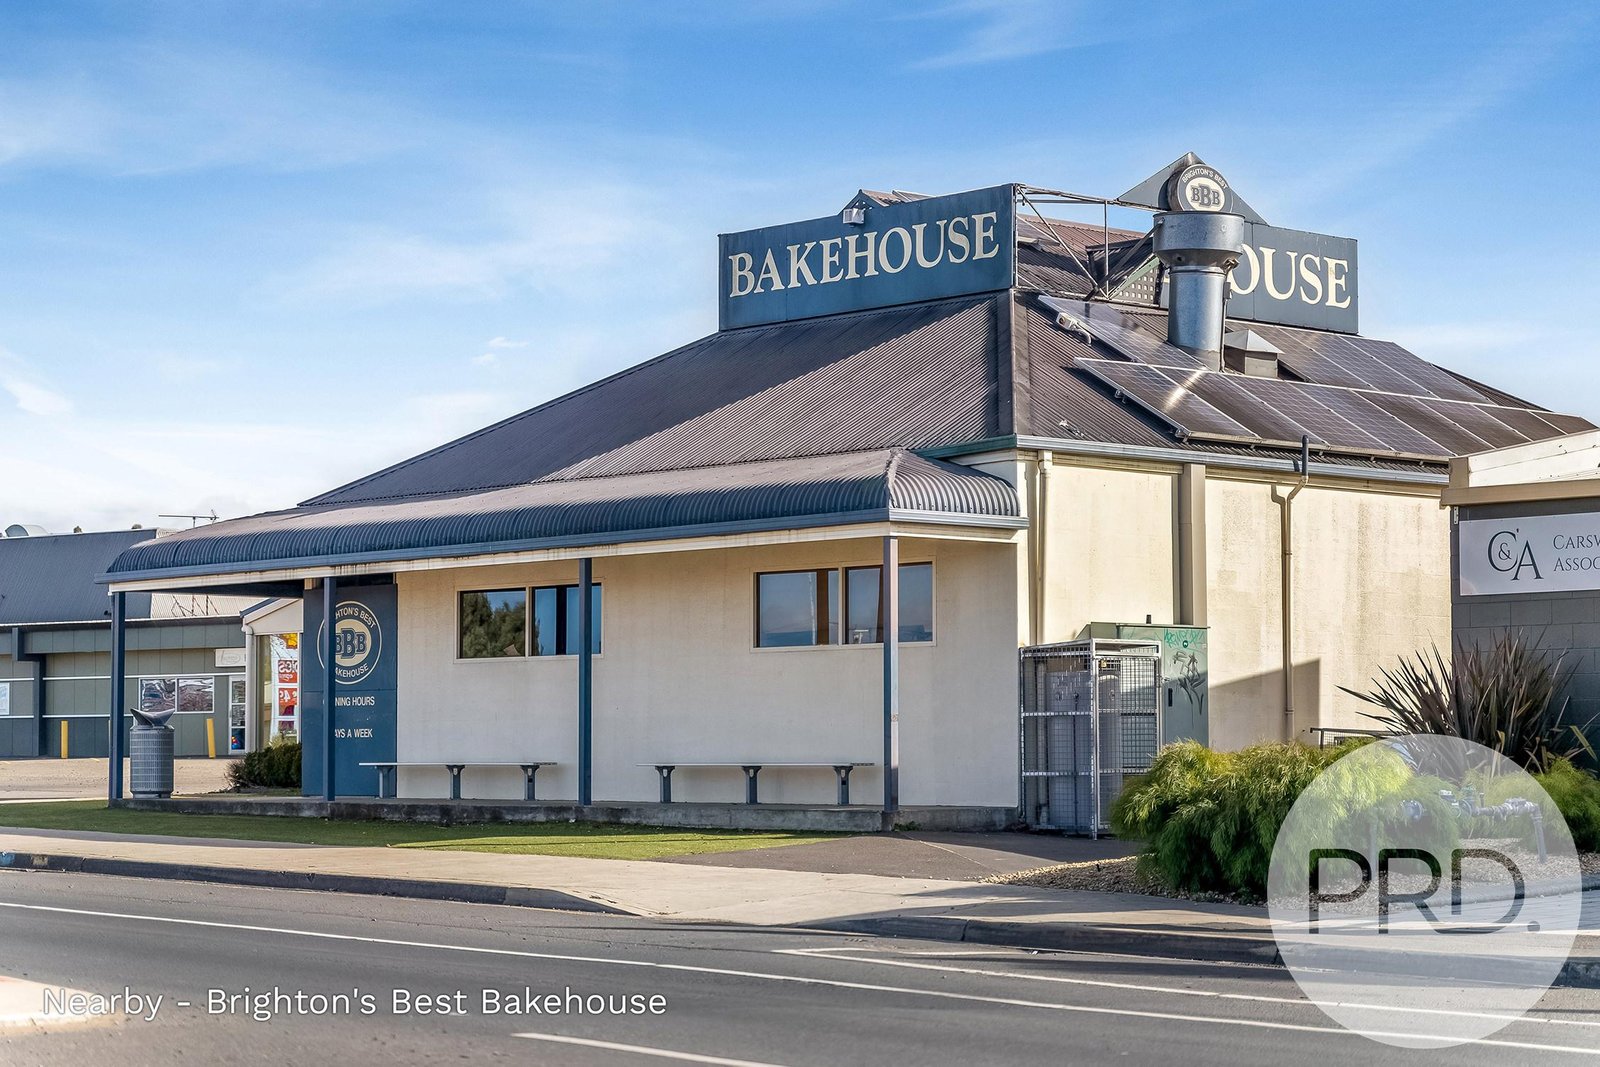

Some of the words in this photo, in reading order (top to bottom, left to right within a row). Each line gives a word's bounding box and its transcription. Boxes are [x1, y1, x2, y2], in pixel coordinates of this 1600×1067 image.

[1182, 168, 1214, 183] BRIGHTON'S
[1214, 173, 1229, 190] BEST
[1190, 183, 1221, 208] BBB
[728, 211, 1000, 298] BAKEHOUSE
[335, 606, 359, 619] HTON'S
[359, 610, 376, 628] BEST
[335, 662, 369, 678] AKEHOUSE
[335, 696, 351, 706] NING
[351, 696, 375, 706] HOURS
[335, 728, 346, 738] AYS
[346, 728, 352, 738] A
[353, 728, 373, 738] WEEK
